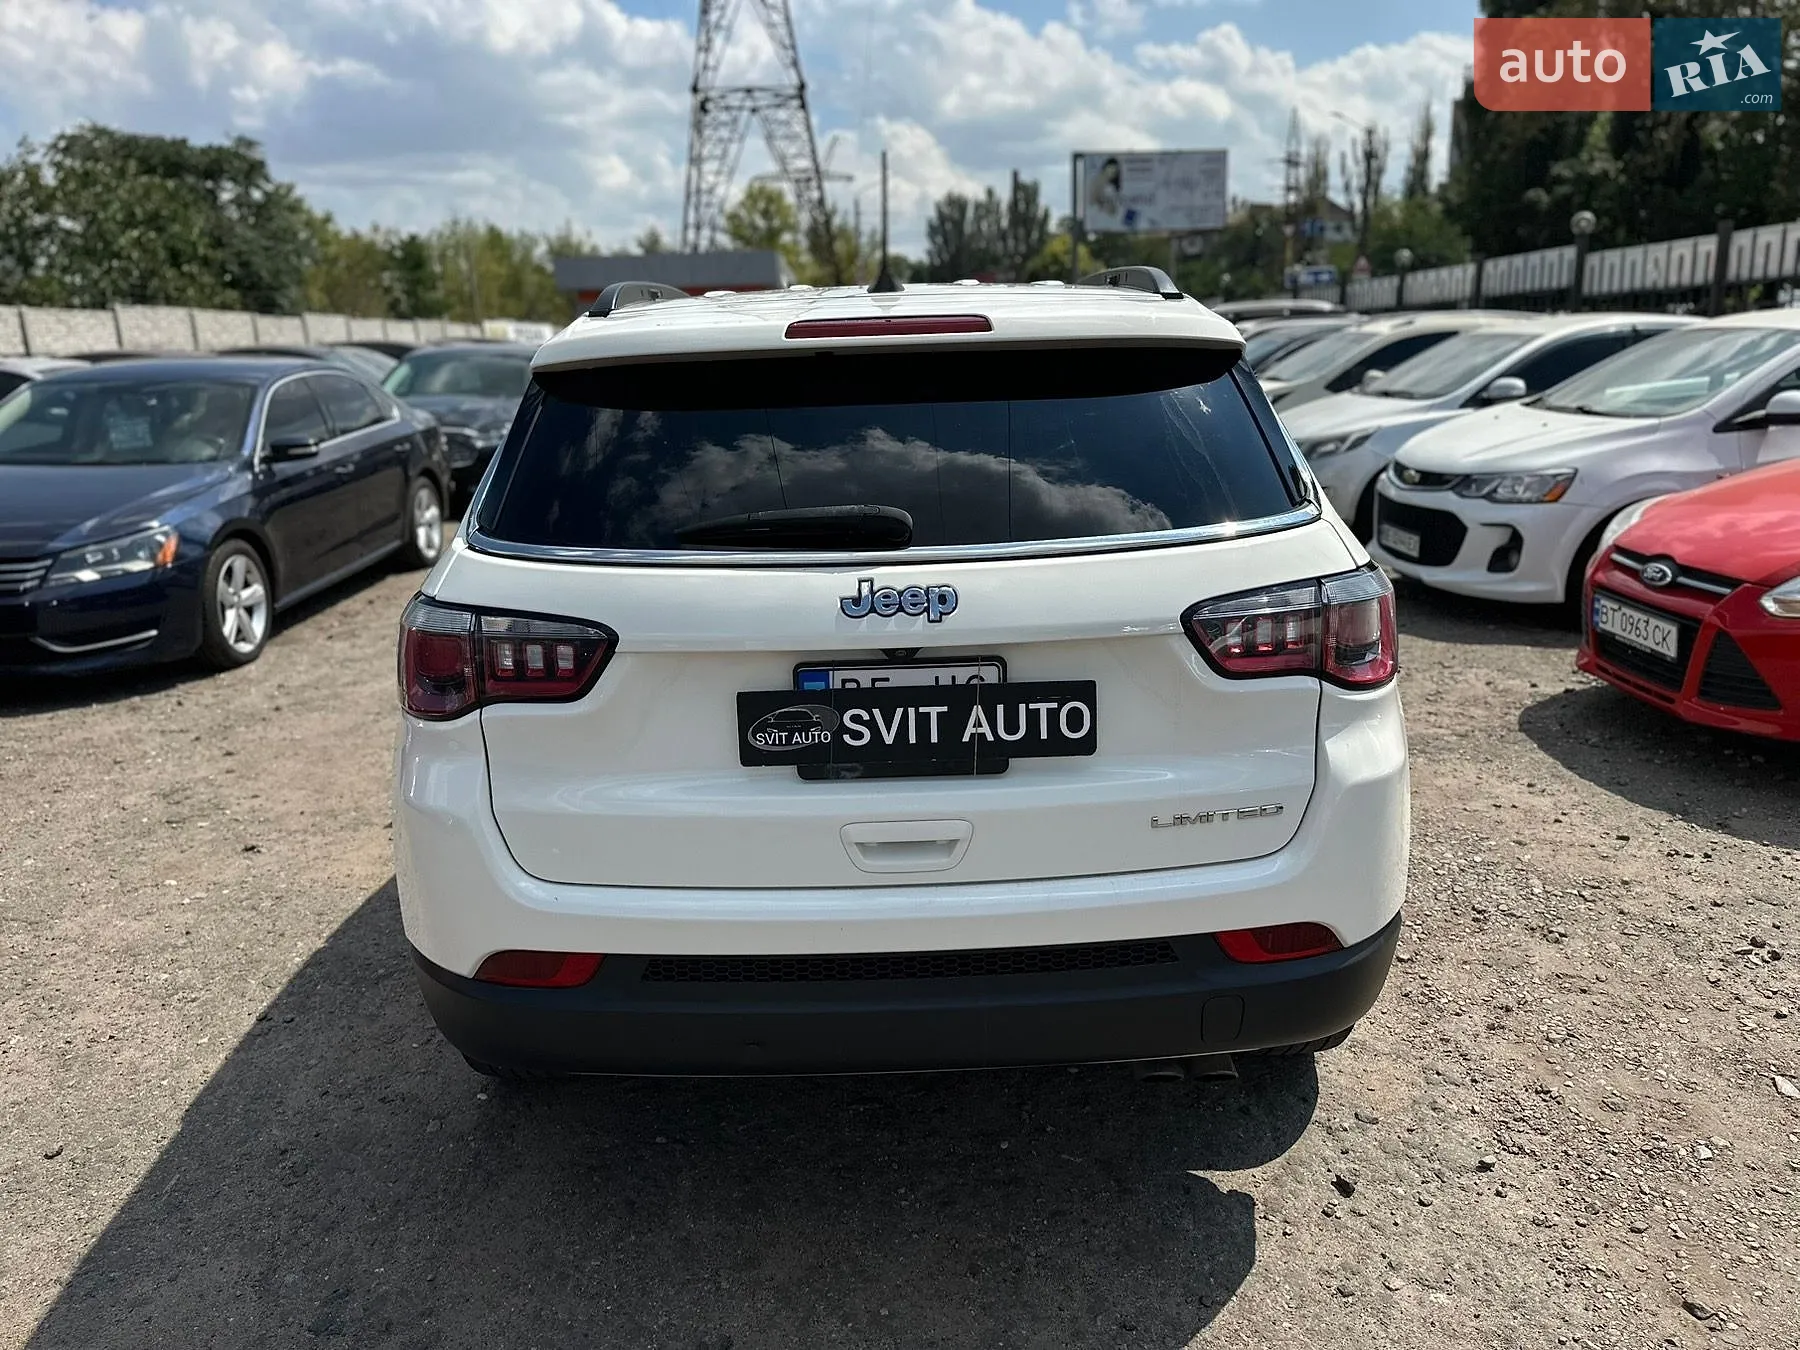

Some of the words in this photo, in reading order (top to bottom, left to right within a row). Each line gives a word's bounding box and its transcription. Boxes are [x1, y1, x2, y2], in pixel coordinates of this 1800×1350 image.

[840, 578, 959, 623] Jeep
[1600, 605, 1619, 629] BT
[1620, 612, 1650, 641] 0963
[1652, 624, 1673, 652] CK
[755, 731, 788, 745] SVIT
[791, 730, 831, 745] AUTO
[842, 706, 948, 747] SVIT
[961, 700, 1092, 743] AUTO
[1150, 802, 1284, 829] LIMITED
